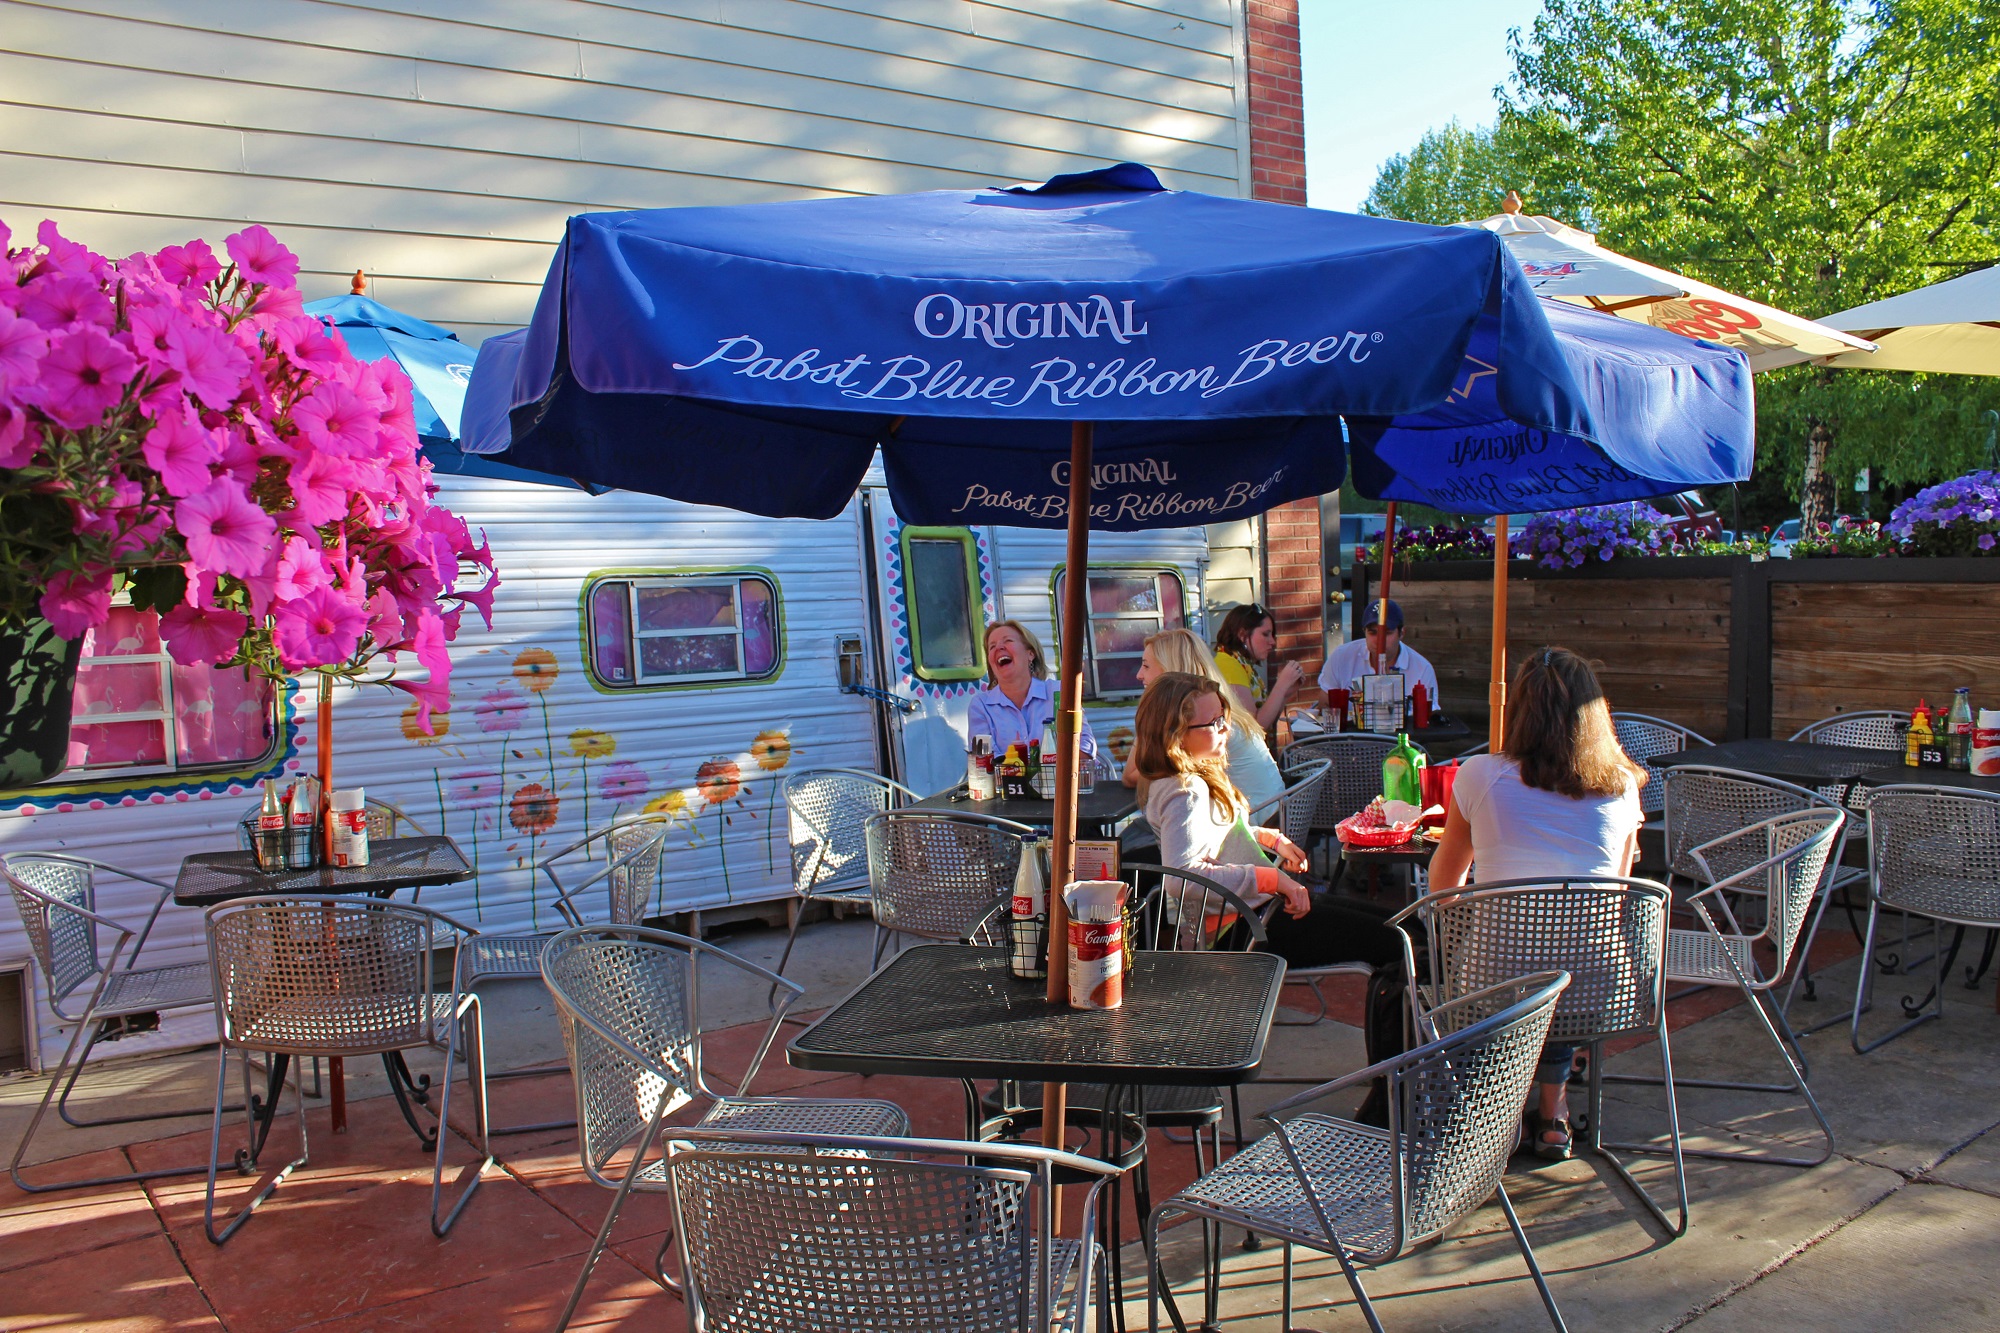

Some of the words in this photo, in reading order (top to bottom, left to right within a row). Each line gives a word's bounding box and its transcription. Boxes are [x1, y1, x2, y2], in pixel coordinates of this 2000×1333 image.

[914, 293, 1148, 349] ORIGINAL
[673, 335, 871, 388] Pabst
[841, 354, 1016, 401] Blue
[991, 356, 1220, 408] Ribbon
[1051, 457, 1177, 491] OIGINAL
[951, 483, 1036, 513] Pabst
[1031, 495, 1111, 519] Bue
[1104, 492, 1217, 523] Ribbon
[1923, 750, 1942, 763] 53
[1008, 784, 1025, 795] 51
